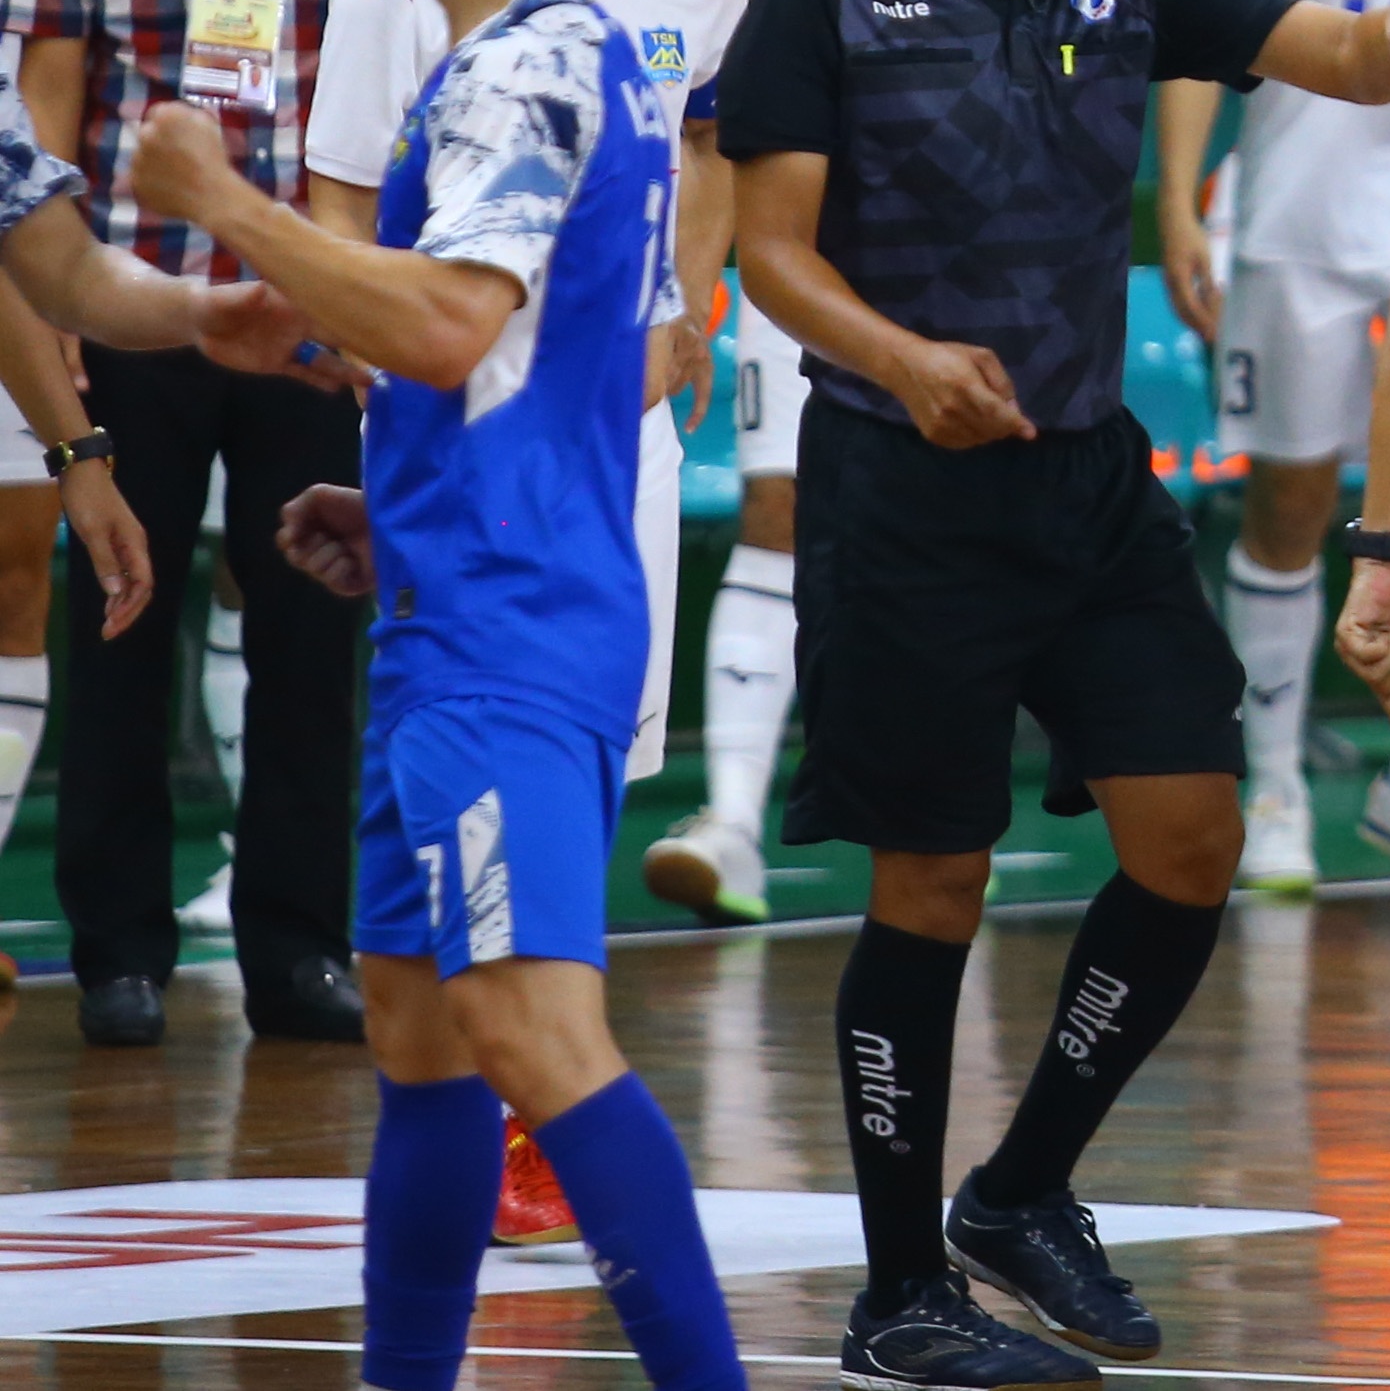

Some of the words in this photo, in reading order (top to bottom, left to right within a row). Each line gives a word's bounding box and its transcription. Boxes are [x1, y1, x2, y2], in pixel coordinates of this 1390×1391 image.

[872, 1, 931, 19] mitre
[651, 32, 678, 45] TSN
[1058, 966, 1129, 1060] mitre
[852, 1029, 912, 1137] mitre
